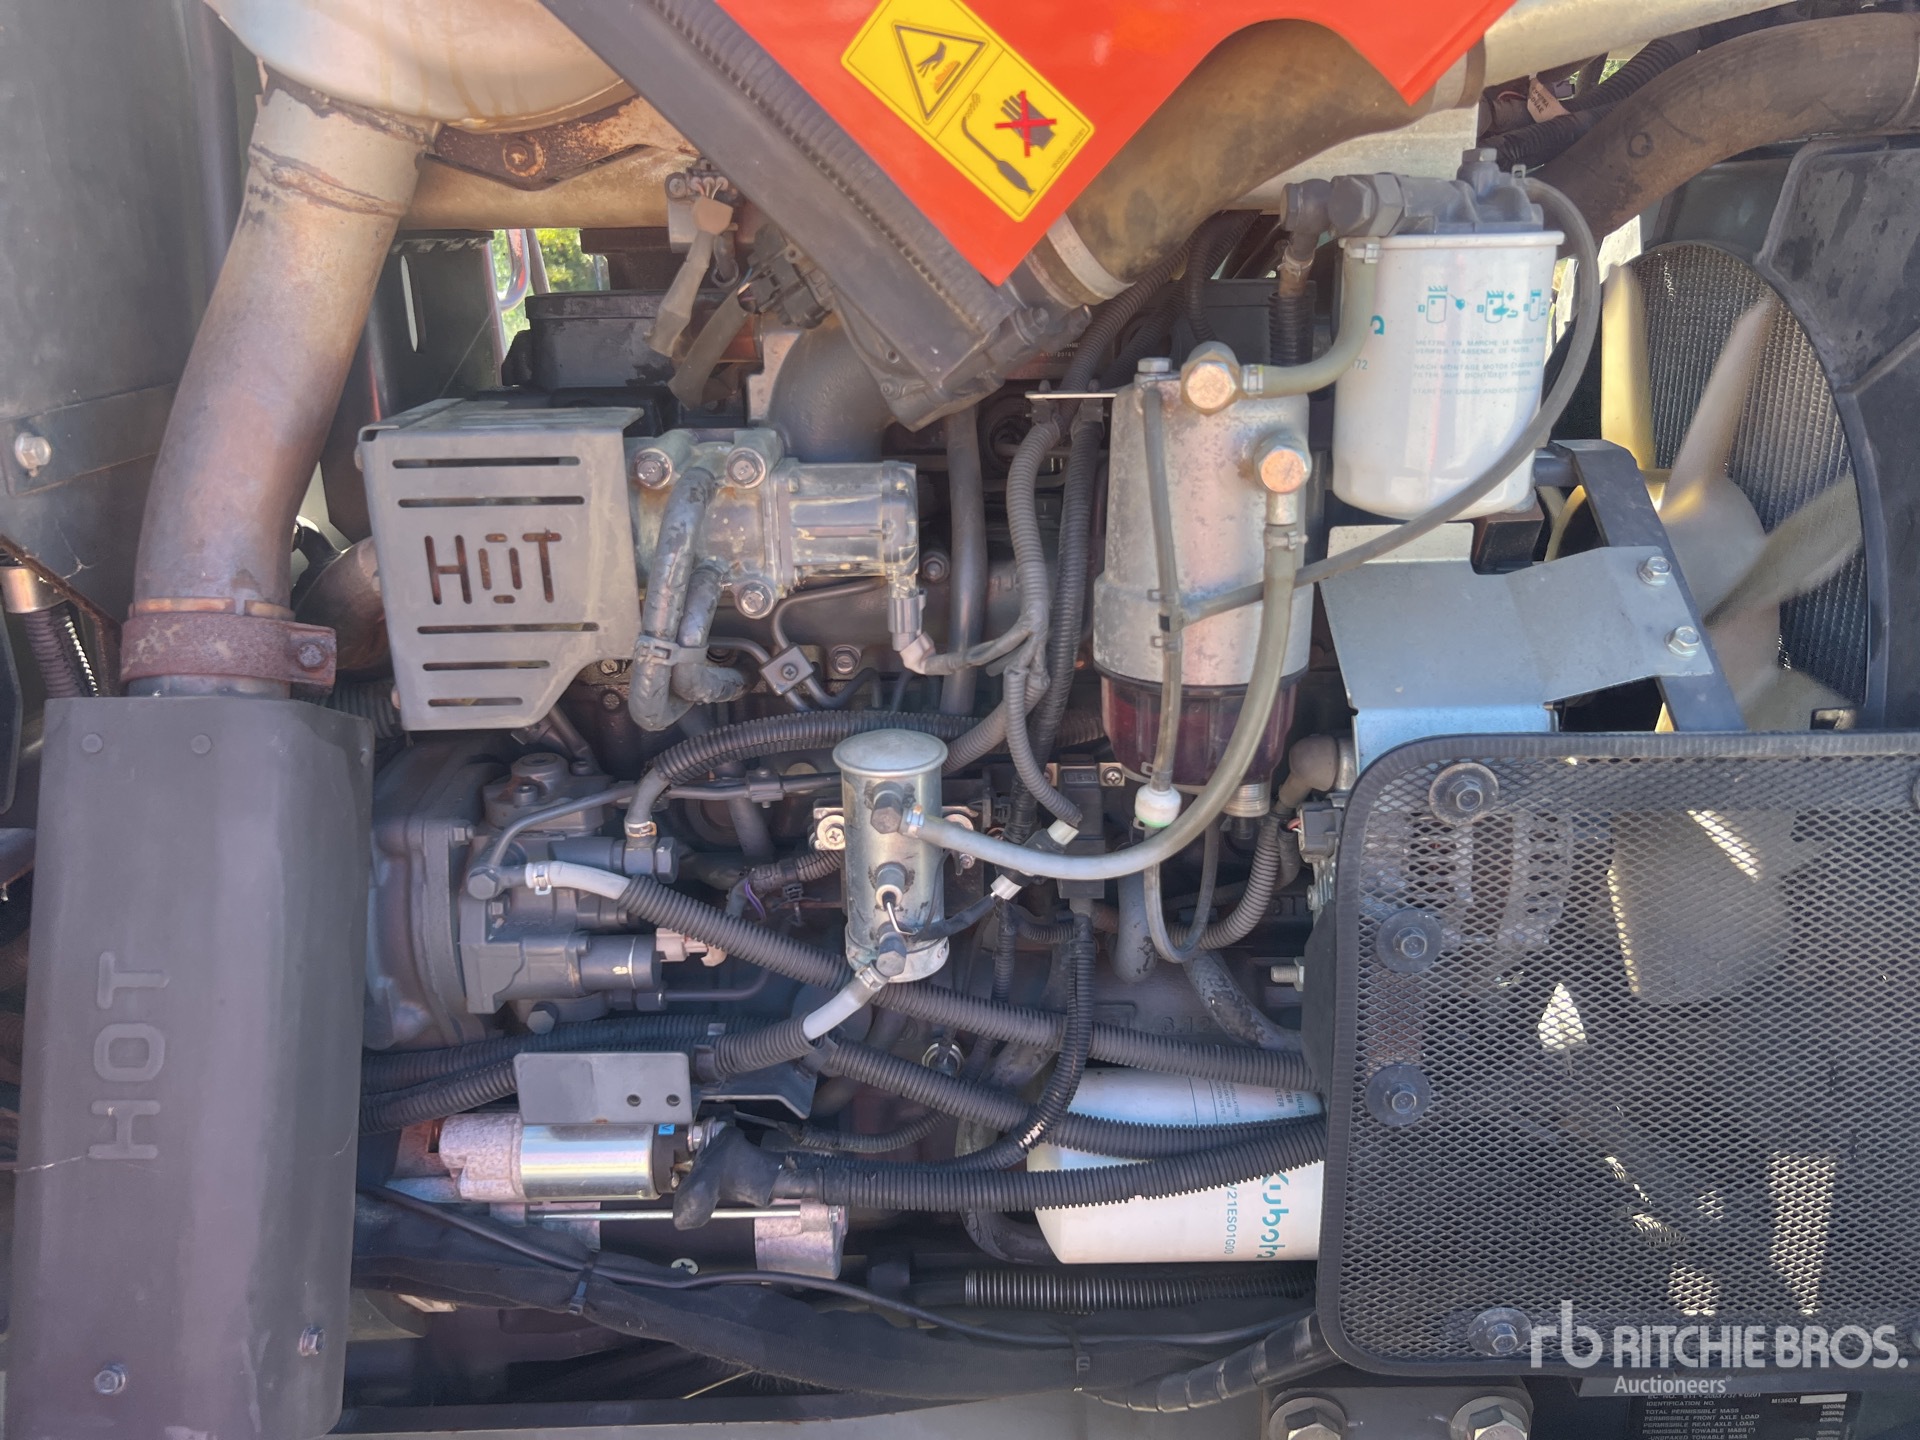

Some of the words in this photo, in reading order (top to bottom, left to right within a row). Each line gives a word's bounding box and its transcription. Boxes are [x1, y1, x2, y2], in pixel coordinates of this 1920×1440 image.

[424, 533, 562, 605] HOT
[88, 951, 170, 1160] HOT
[1275, 1088, 1285, 1107] ILTER
[1295, 1093, 1306, 1114] HUILE
